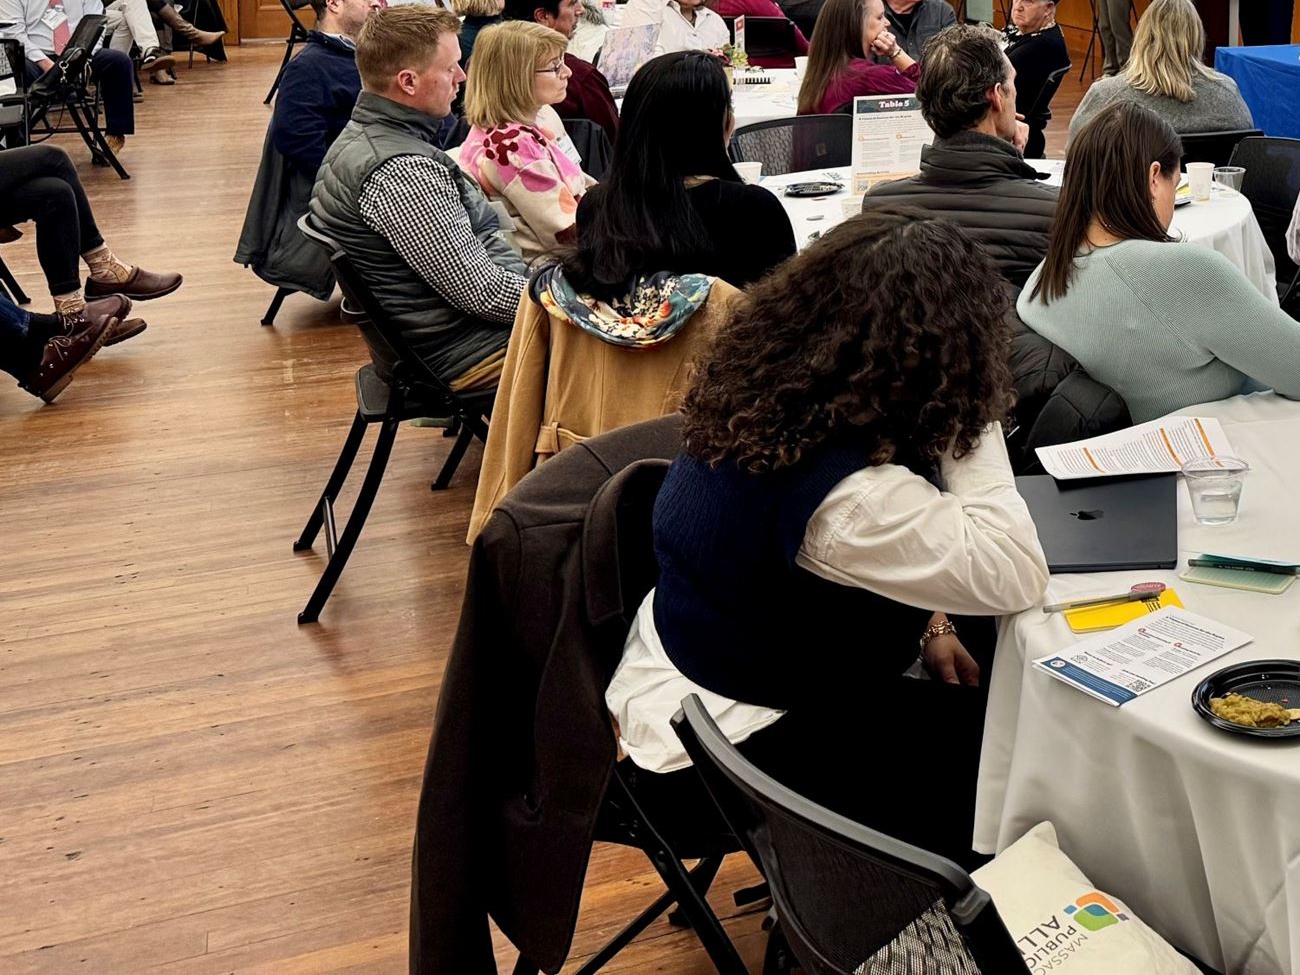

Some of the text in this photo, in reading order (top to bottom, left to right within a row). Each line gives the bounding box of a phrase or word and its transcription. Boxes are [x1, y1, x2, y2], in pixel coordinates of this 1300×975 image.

[879, 99, 910, 109] Table 5
[1017, 915, 1061, 955] ALL
